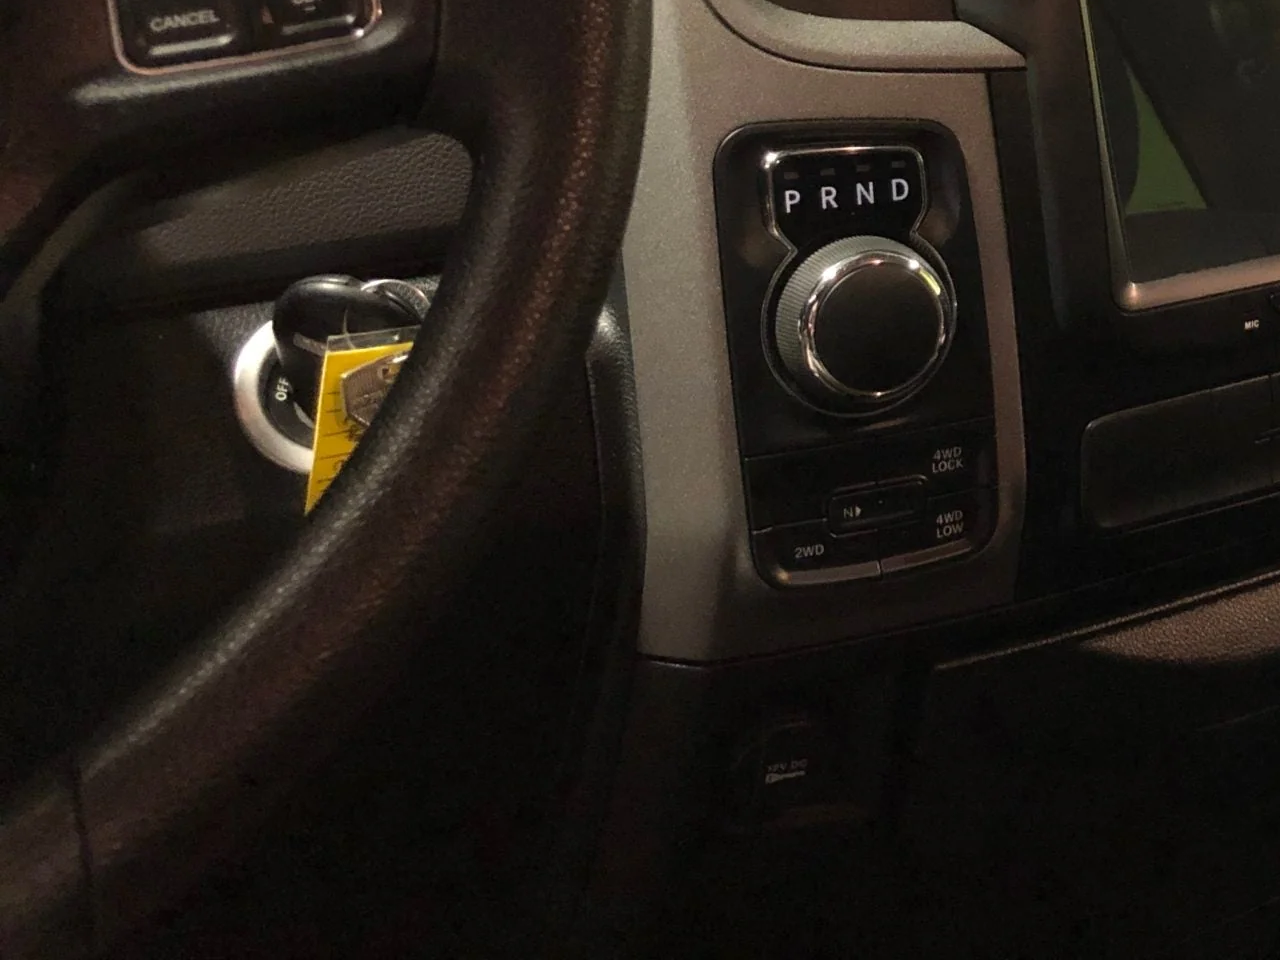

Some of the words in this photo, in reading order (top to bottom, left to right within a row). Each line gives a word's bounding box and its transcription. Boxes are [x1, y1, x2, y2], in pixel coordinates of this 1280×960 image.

[150, 9, 219, 32] CANCEL
[784, 190, 801, 214] P
[820, 186, 838, 210] R
[856, 182, 875, 206] N
[891, 178, 909, 201] D
[1244, 319, 1260, 330] MIC
[275, 376, 289, 401] OFF
[932, 446, 962, 460] 4WD
[931, 458, 964, 473] LOCK
[936, 510, 963, 525] 4WD
[936, 522, 964, 539] LOW
[794, 543, 824, 558] 2WD
